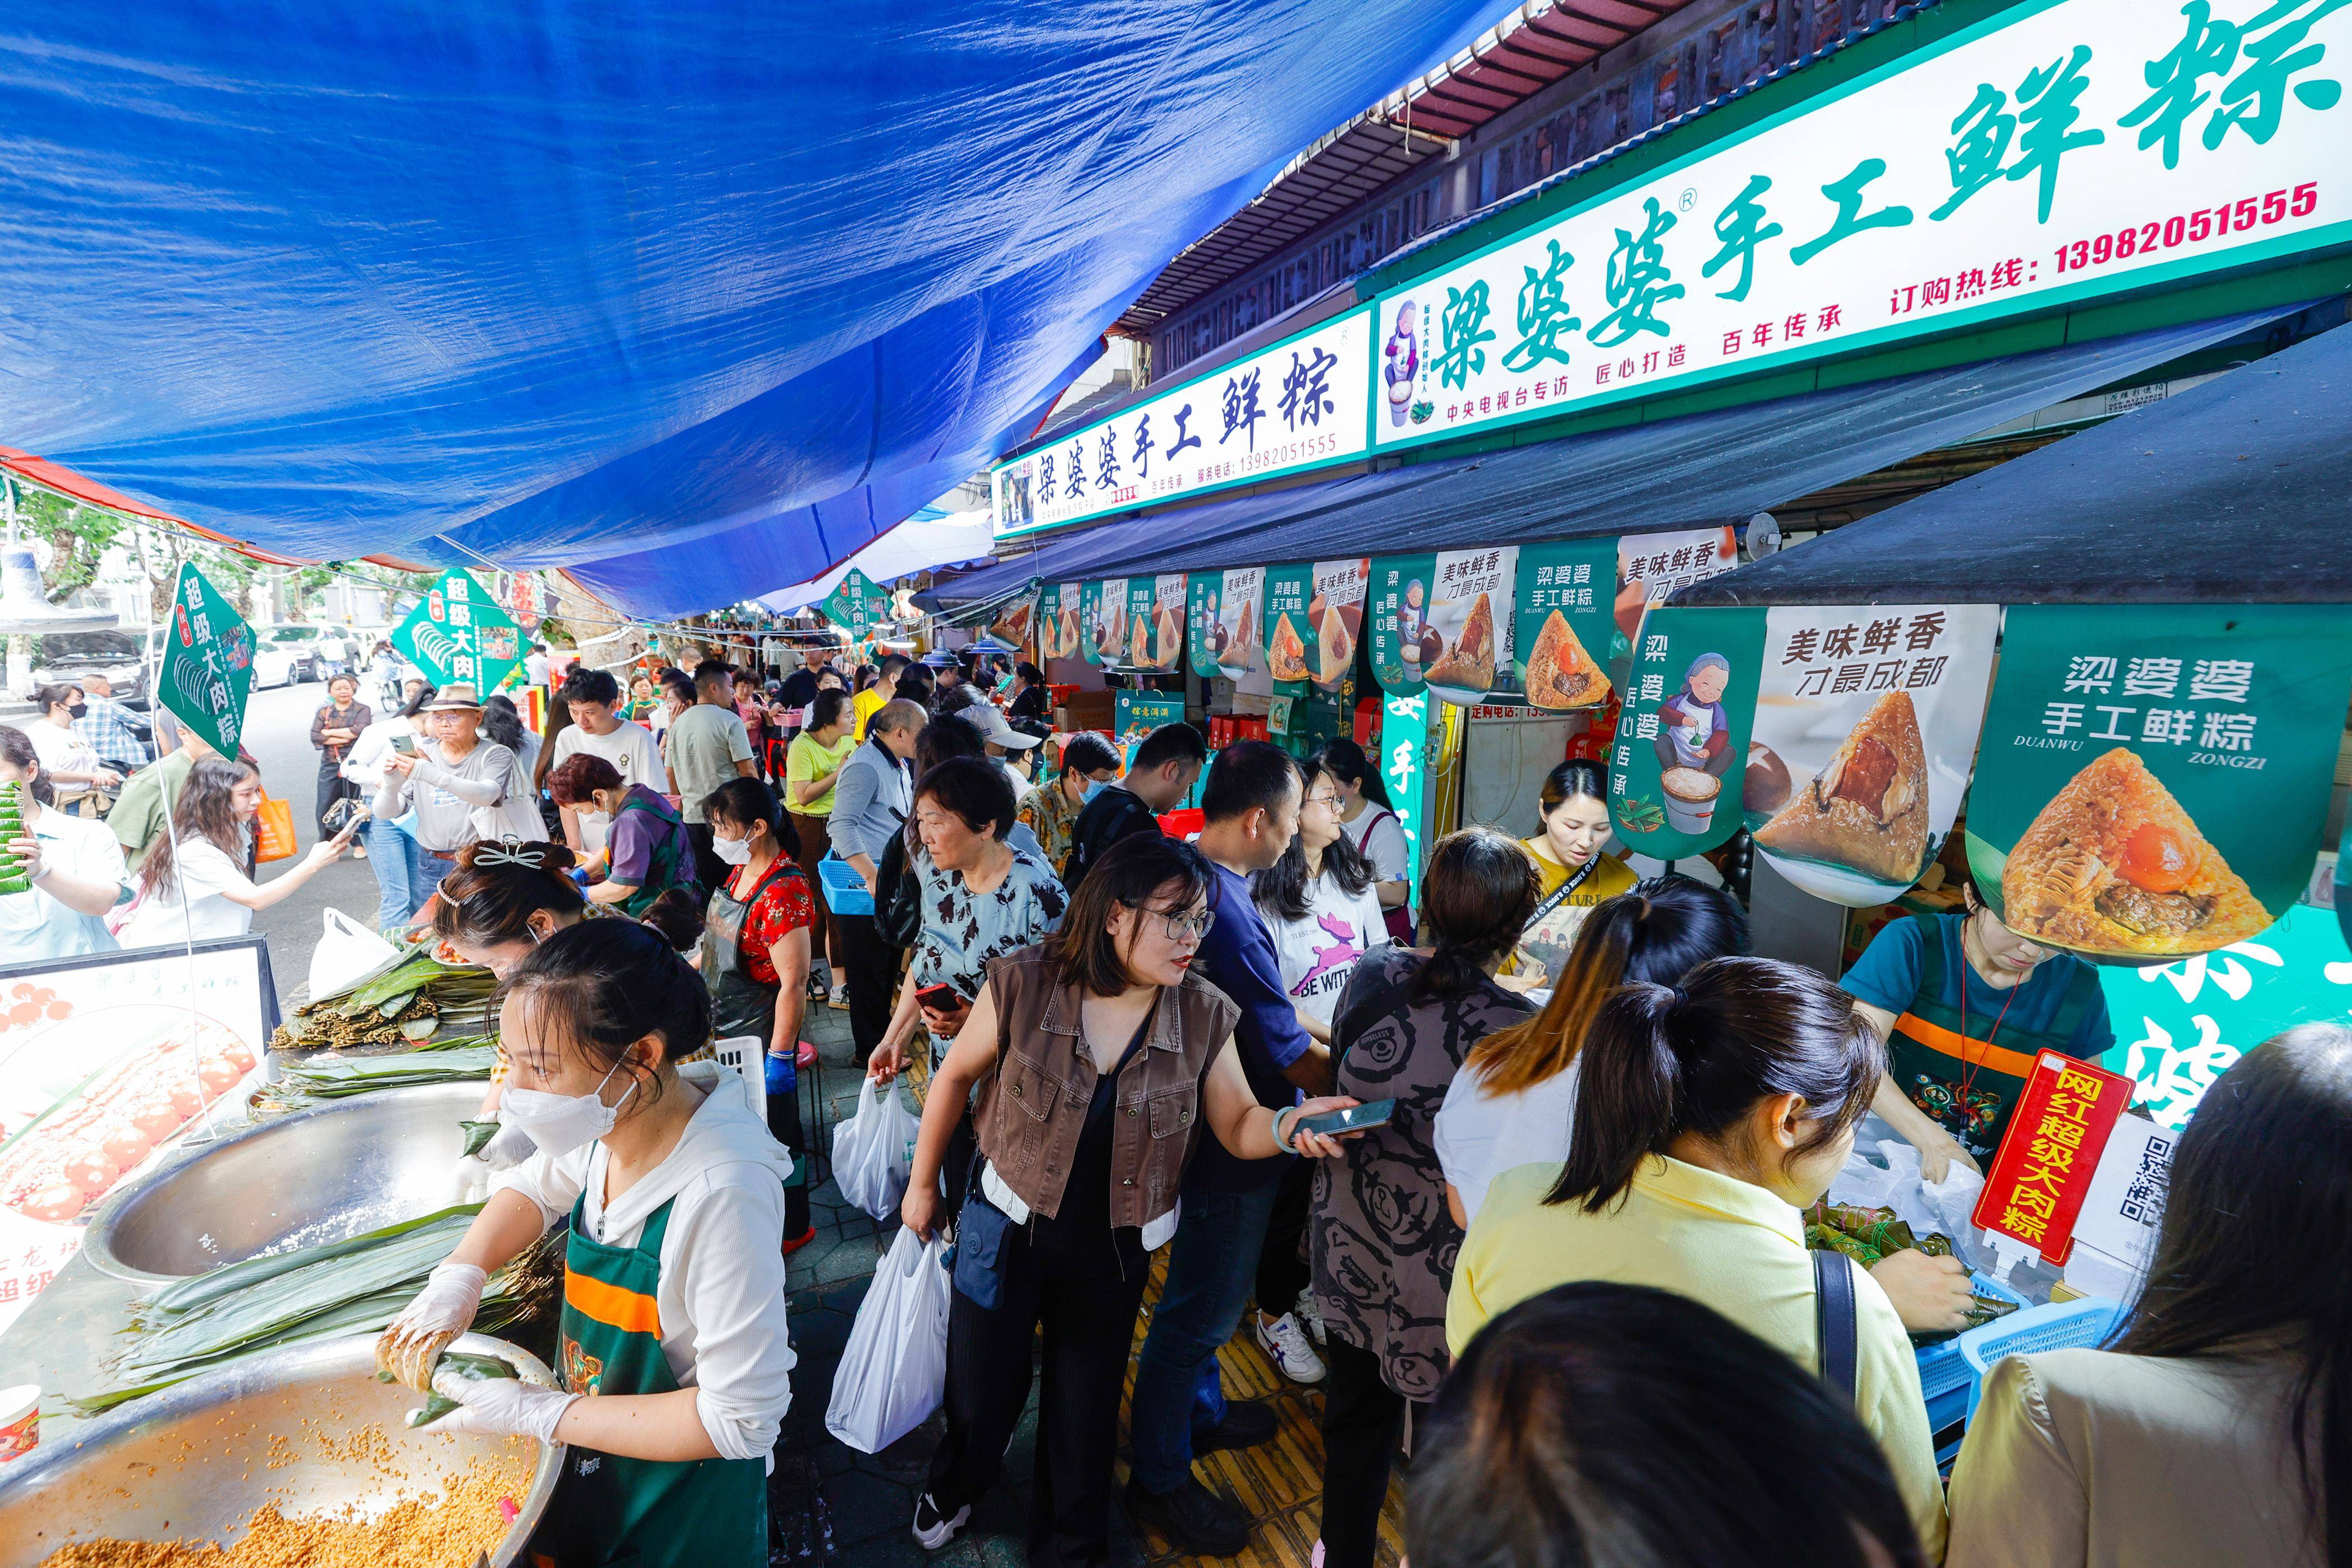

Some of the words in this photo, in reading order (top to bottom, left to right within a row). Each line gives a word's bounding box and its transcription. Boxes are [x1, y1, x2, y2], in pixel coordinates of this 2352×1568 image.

[1430, 0, 2352, 391] 梁婆婆手工鲜粽
[1446, 375, 1569, 422] 中央电视台专访
[1595, 344, 1687, 385] 匠心打造
[1722, 304, 1841, 356] 百年传承
[1037, 347, 1338, 505] 梁婆婆手工鲜粽
[1151, 474, 1183, 494] 百年传承
[1227, 570, 1256, 592] 美味鲜香
[1316, 567, 1357, 594] 美味鲜香
[1441, 550, 1500, 584] 美味鲜香
[1536, 563, 1592, 585] 梁婆婆
[1626, 540, 1716, 583] 美味鲜香
[850, 574, 866, 636] 超级大肉粽
[1132, 590, 1149, 601] 梁婆婆
[1157, 580, 1181, 601] 美味鲜香
[1271, 598, 1302, 610] 手工鲜粽
[1275, 581, 1300, 595] 梁婆婆
[1386, 570, 1399, 632] 梁婆婆
[1532, 587, 1593, 606] 手工鲜粽
[446, 577, 476, 688] 超级大肉
[1376, 601, 1385, 665] 匠心传承
[1782, 610, 1945, 665] 美味鲜香
[184, 576, 239, 748] 超级大肉粽
[2062, 656, 2255, 703] 梁婆婆
[1636, 634, 1668, 741] 梁婆婆
[1612, 687, 1637, 796] 匠心传承
[2041, 702, 2257, 752] 手工鲜粽
[2013, 735, 2084, 752] DUANWU
[2188, 752, 2267, 770] ZONGZI
[1545, 891, 1564, 908] B.DUCK
[1569, 871, 1585, 888] B.DUCK
[1300, 978, 1319, 998] BE
[1999, 1068, 2103, 1244] 网红超级大肉粽
